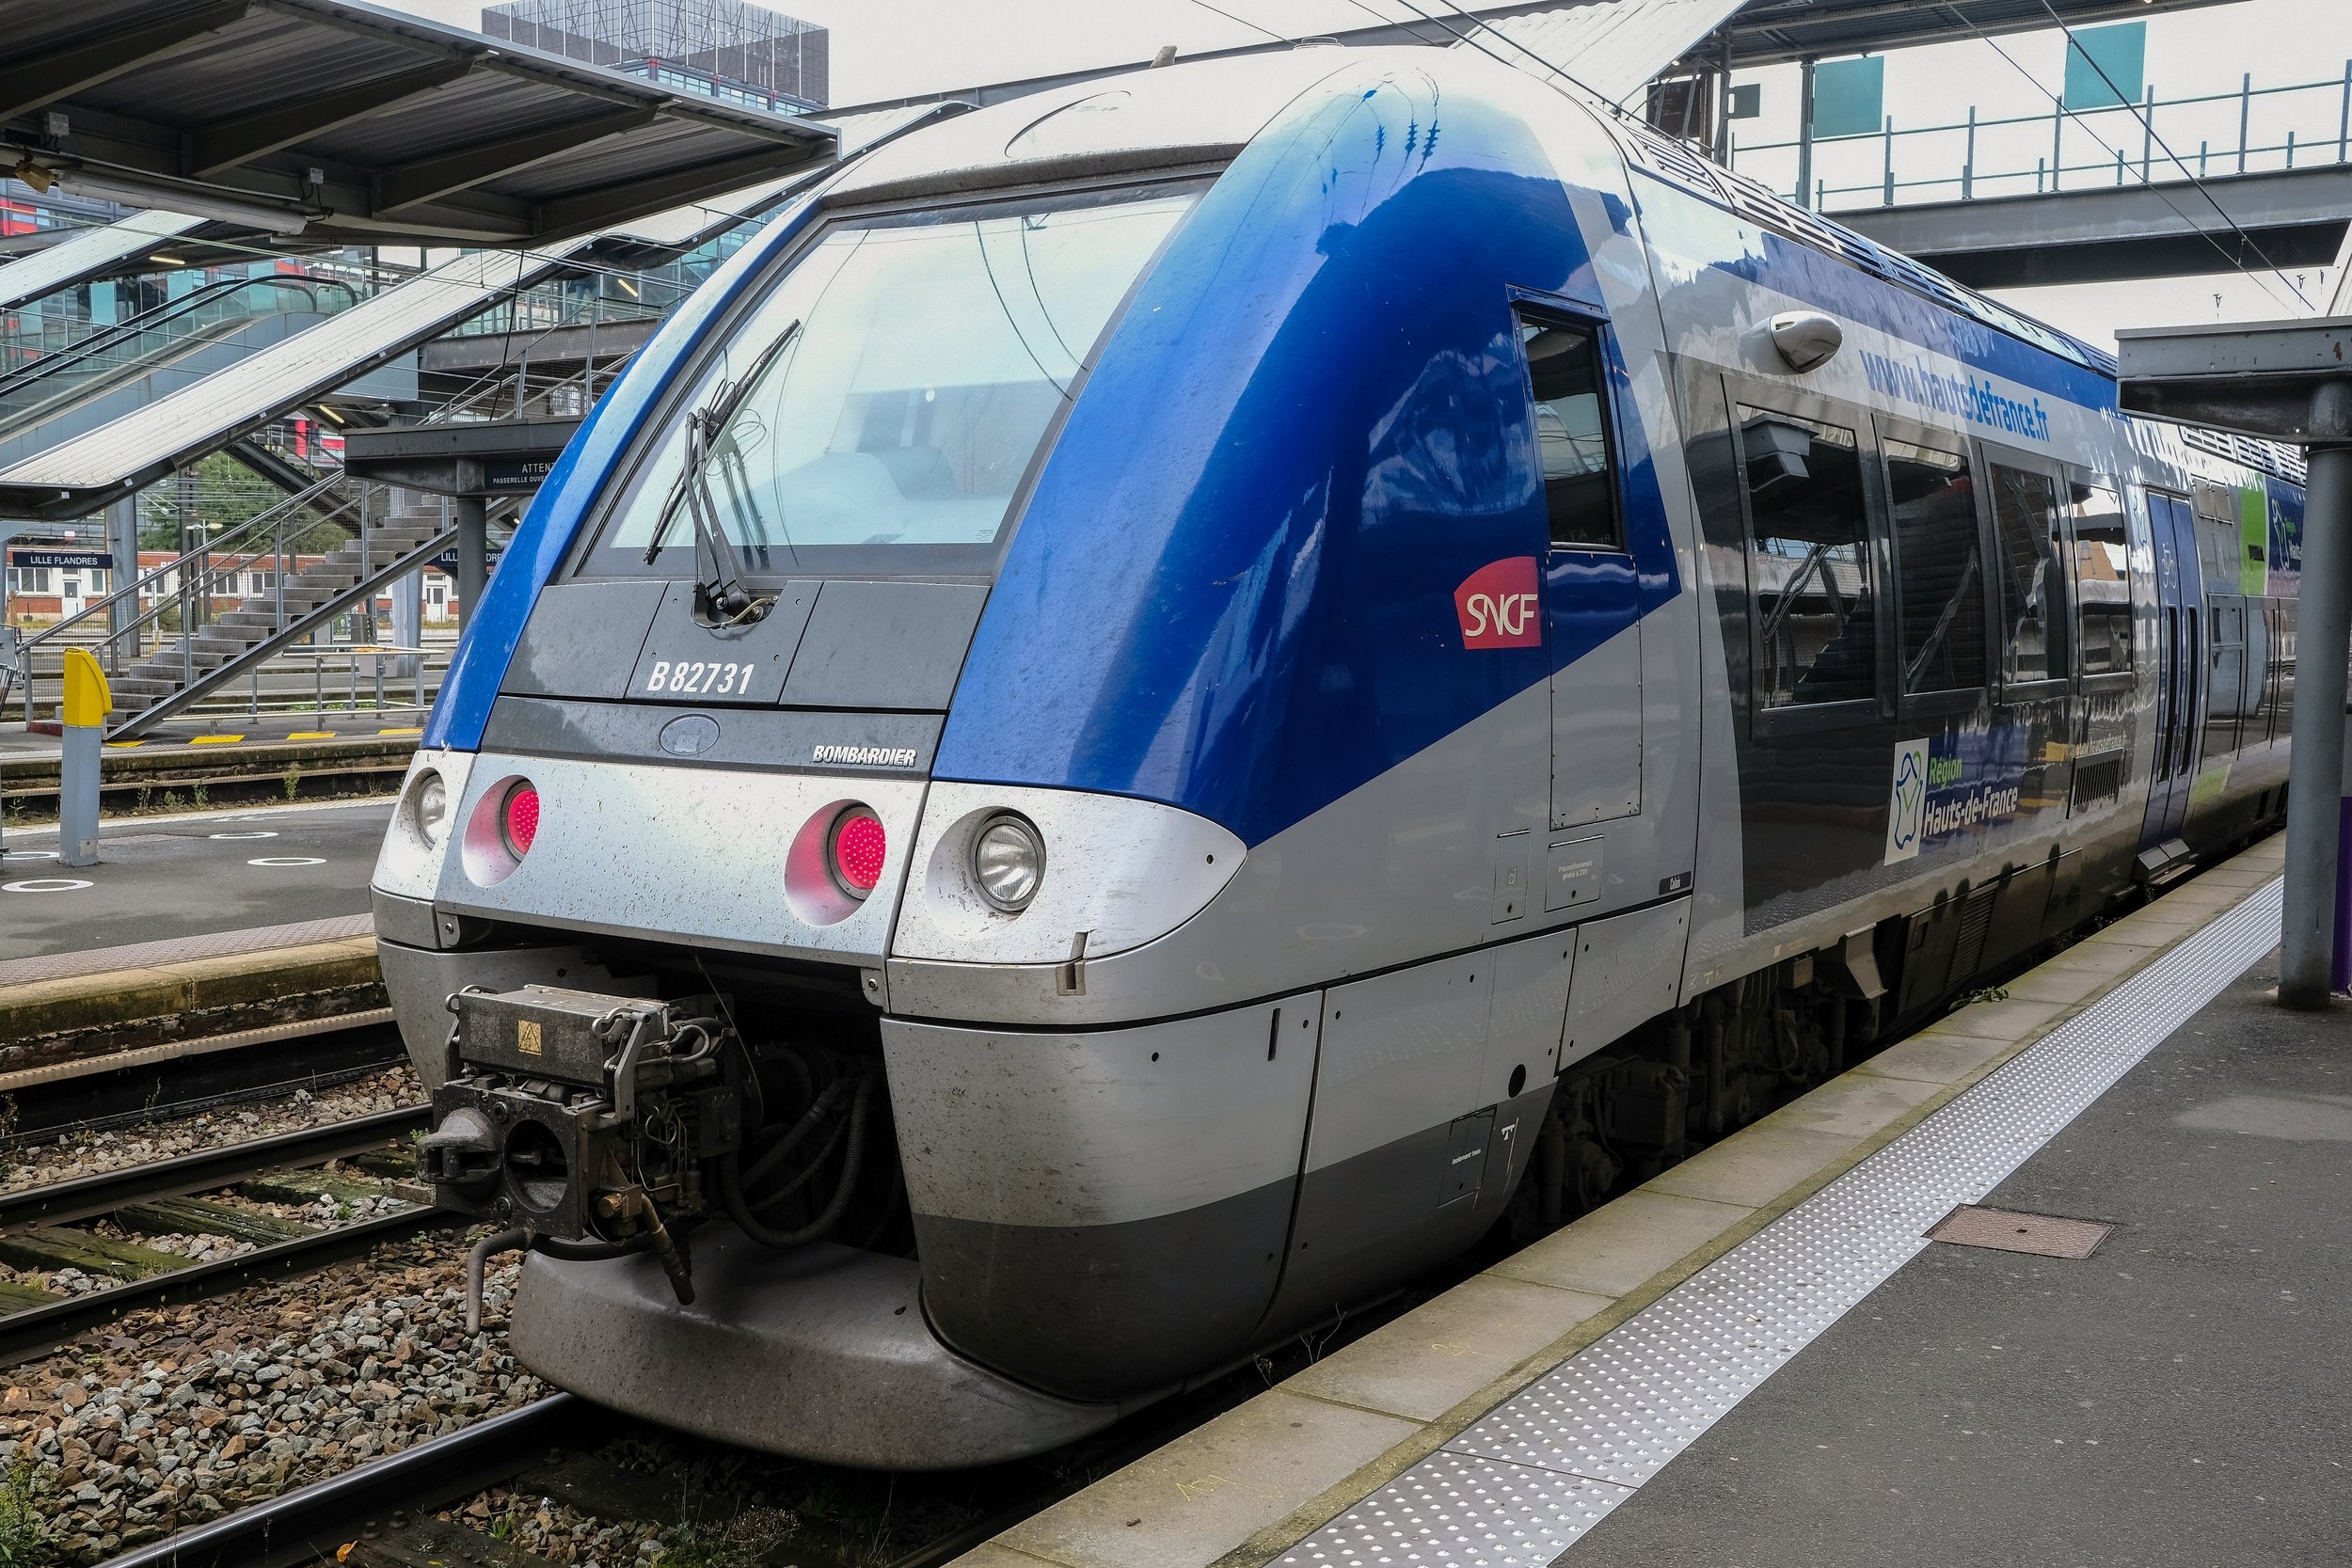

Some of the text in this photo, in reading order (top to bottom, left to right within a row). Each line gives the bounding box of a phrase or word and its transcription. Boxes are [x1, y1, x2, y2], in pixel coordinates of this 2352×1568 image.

[1859, 349, 2050, 442] www.hautsdefrance.fr
[492, 476, 528, 484] PASSERELLE
[30, 556, 98, 565] LILLE FLANDRES
[1464, 594, 1538, 637] SNCF
[646, 661, 755, 695] B 82731
[812, 745, 917, 768] BOMBARDIER
[1929, 755, 1963, 789] Région
[1922, 785, 2019, 838] Hauts-de-France
